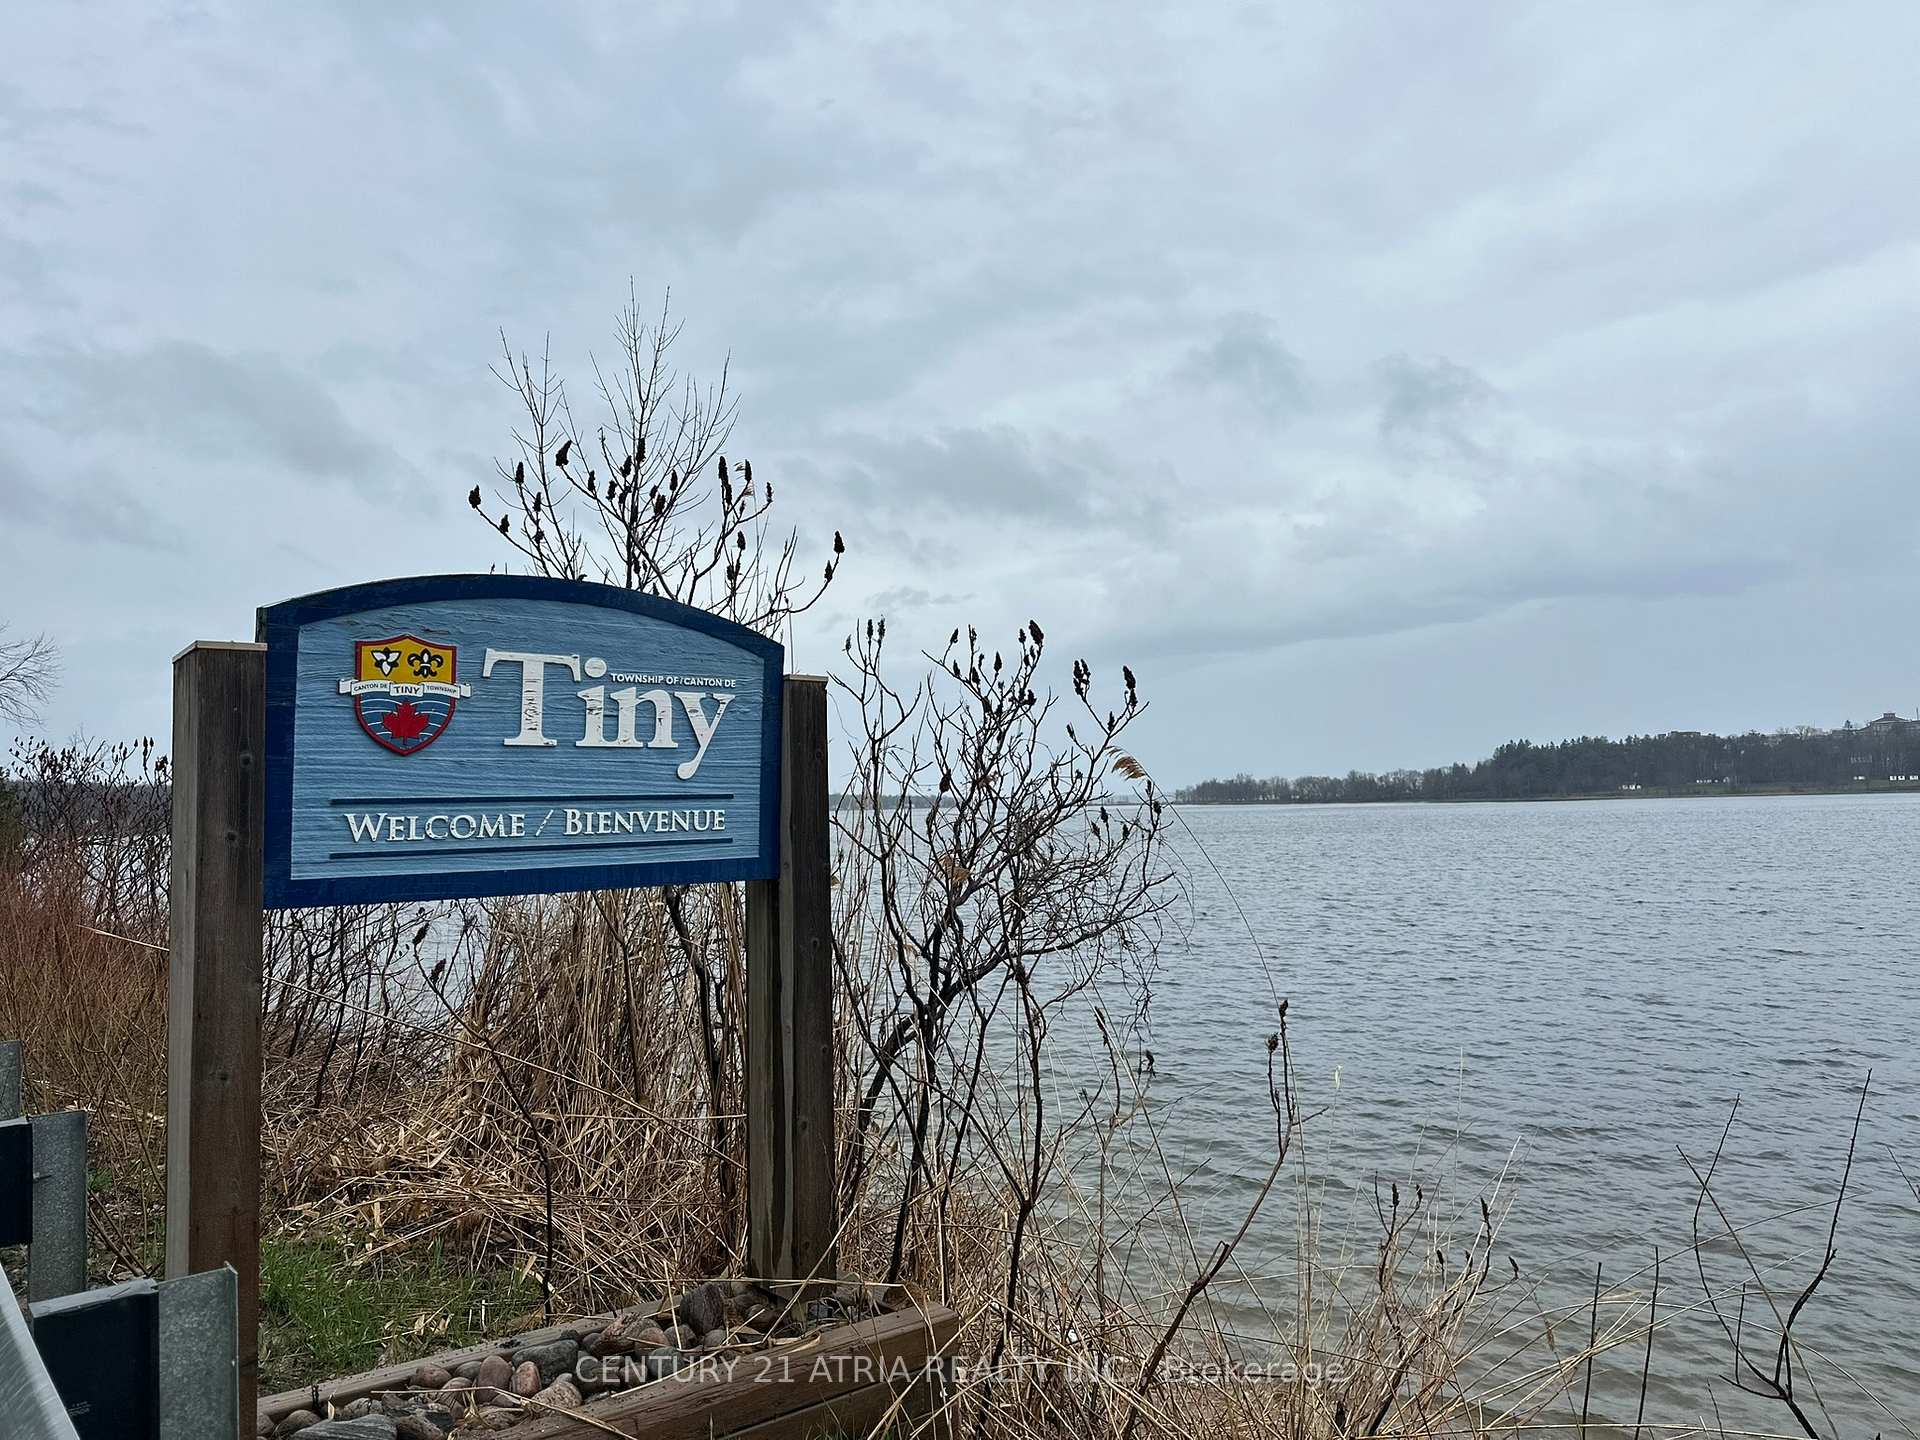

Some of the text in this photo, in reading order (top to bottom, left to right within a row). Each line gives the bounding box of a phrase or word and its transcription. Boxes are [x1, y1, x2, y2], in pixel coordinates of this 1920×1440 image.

[610, 673, 664, 684] TOWNSHIP
[724, 679, 736, 688] DE
[353, 683, 378, 692] CANTON
[394, 685, 420, 695] TINY
[426, 685, 457, 694] TOWNSHIP
[482, 648, 735, 780] Tiny
[344, 812, 526, 843] WELCOME
[563, 808, 726, 836] BIENVENUE
